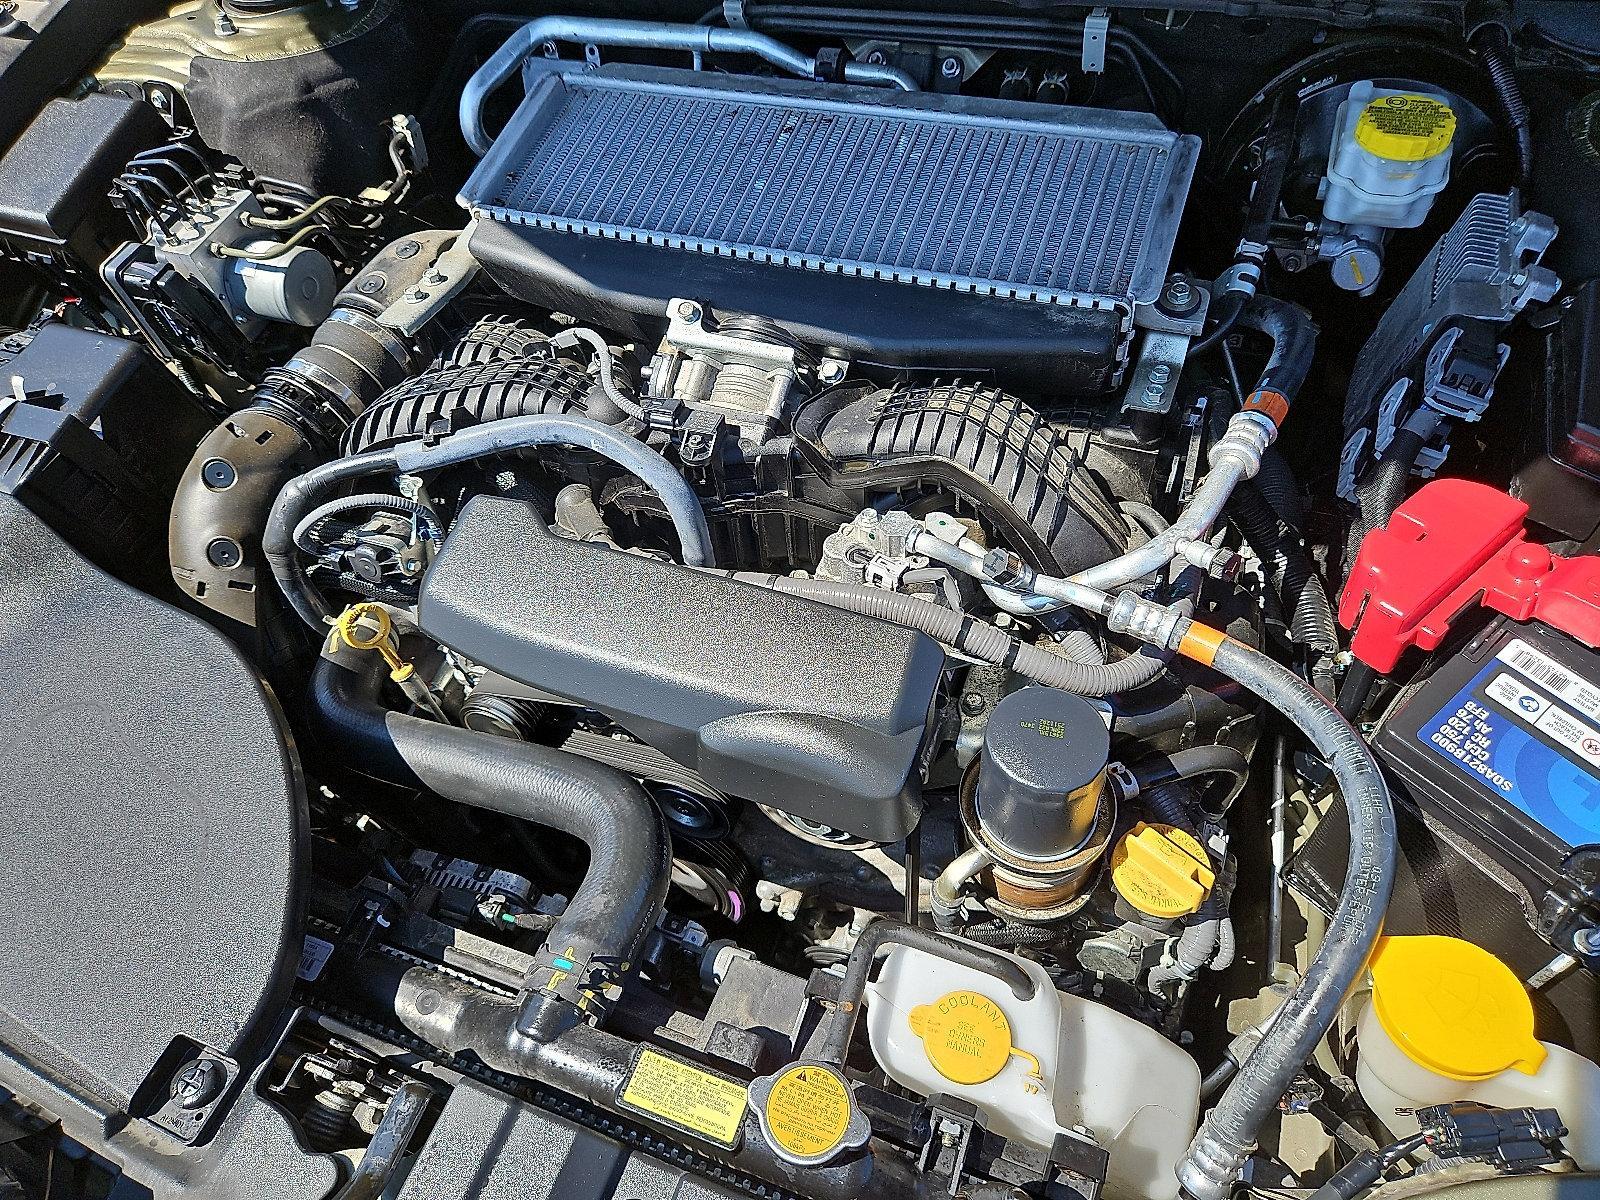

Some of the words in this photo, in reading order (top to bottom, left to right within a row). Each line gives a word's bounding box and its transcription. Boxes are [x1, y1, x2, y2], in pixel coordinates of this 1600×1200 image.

[1456, 709, 1473, 724] 76
[1464, 701, 1489, 721] EFB
[1440, 725, 1464, 745] 750
[1447, 716, 1471, 735] 120
[1473, 719, 1493, 735] Ah
[1464, 740, 1489, 760] CCA
[1470, 733, 1492, 749] RC
[938, 994, 1007, 1031] COOLANT
[809, 1074, 839, 1092] WARNING
